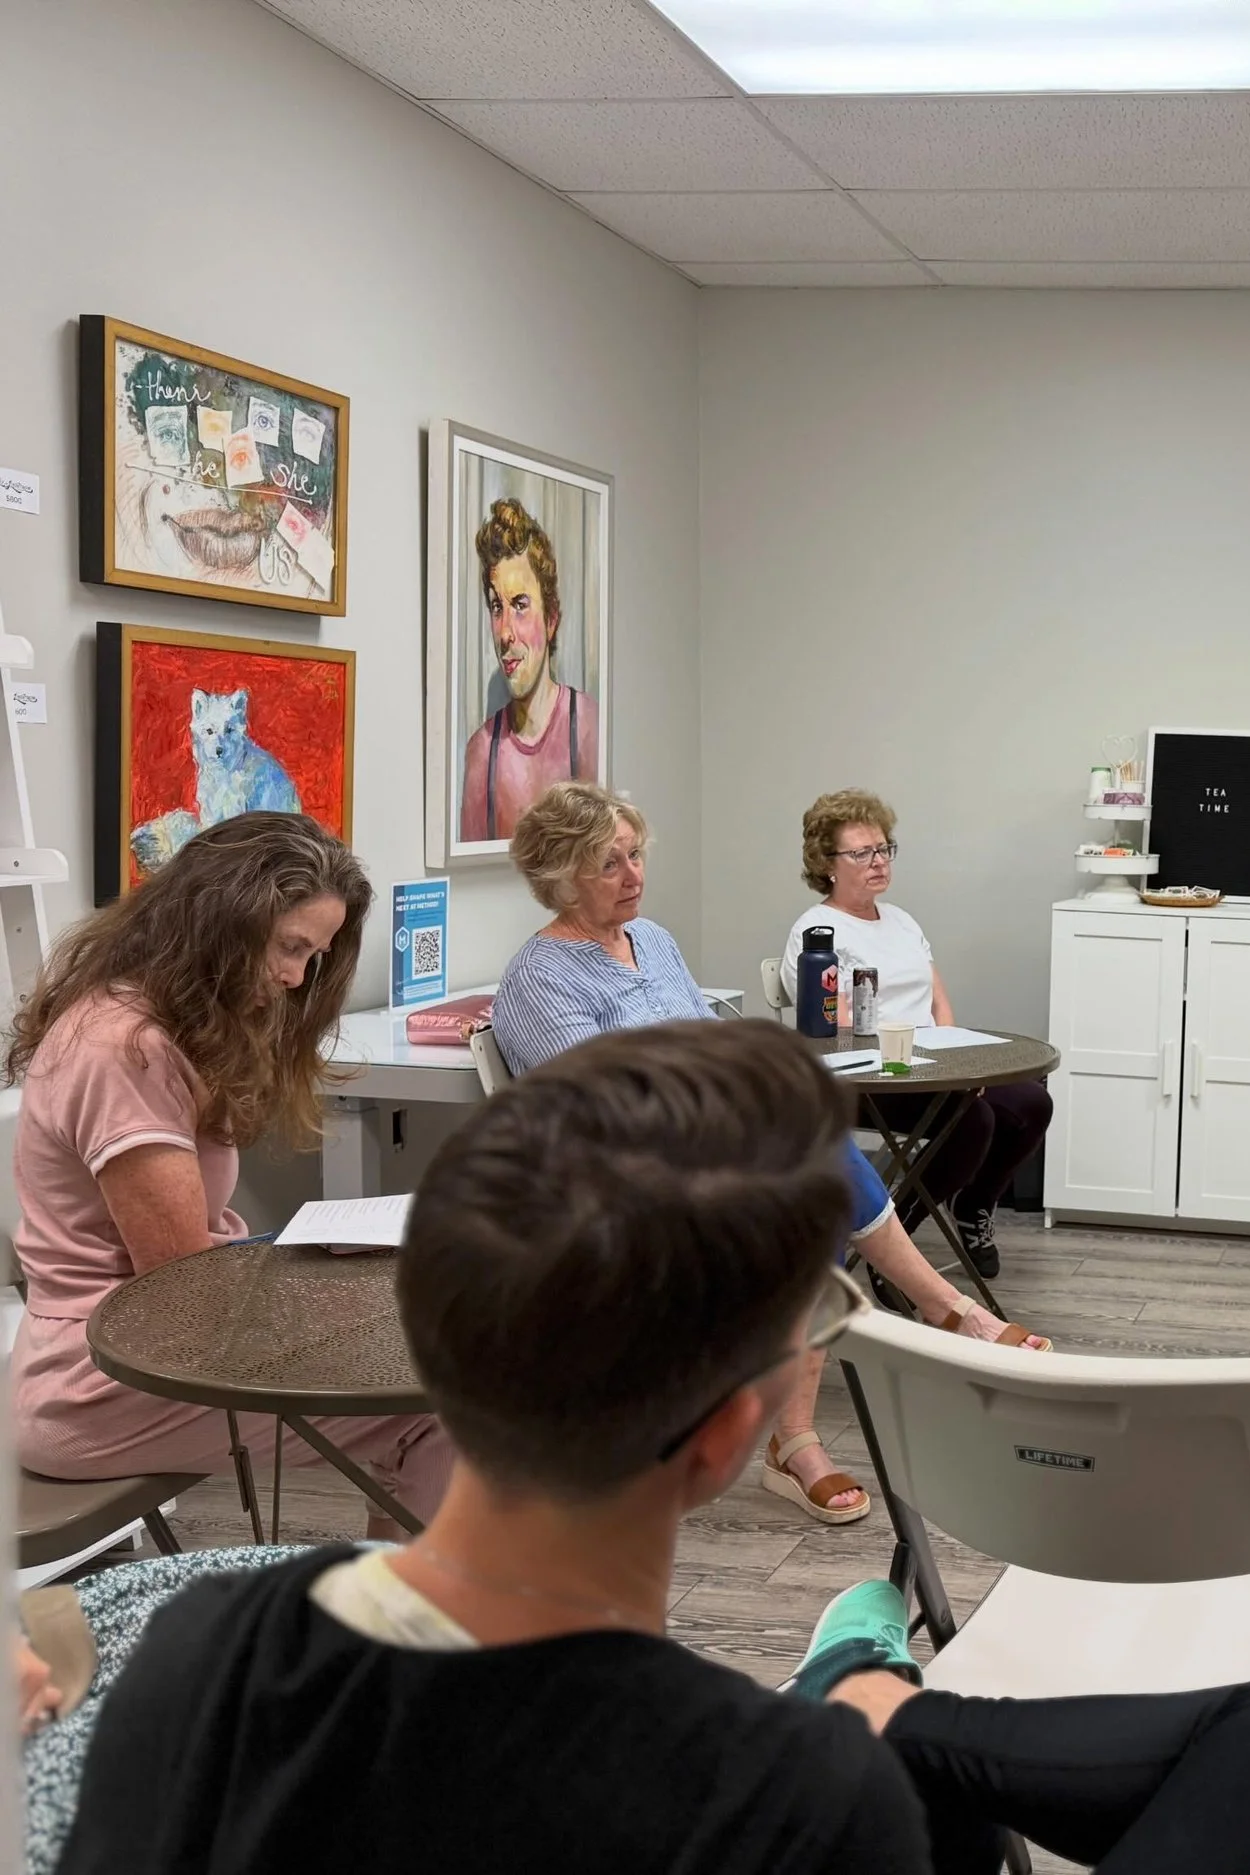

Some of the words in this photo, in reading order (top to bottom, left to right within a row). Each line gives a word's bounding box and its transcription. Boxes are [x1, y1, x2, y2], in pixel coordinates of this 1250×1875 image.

[191, 451, 220, 479] he
[1205, 787, 1227, 797] TEA
[1199, 803, 1230, 814] TIME
[826, 973, 838, 987] M
[1025, 1449, 1086, 1468] LIFETIME
